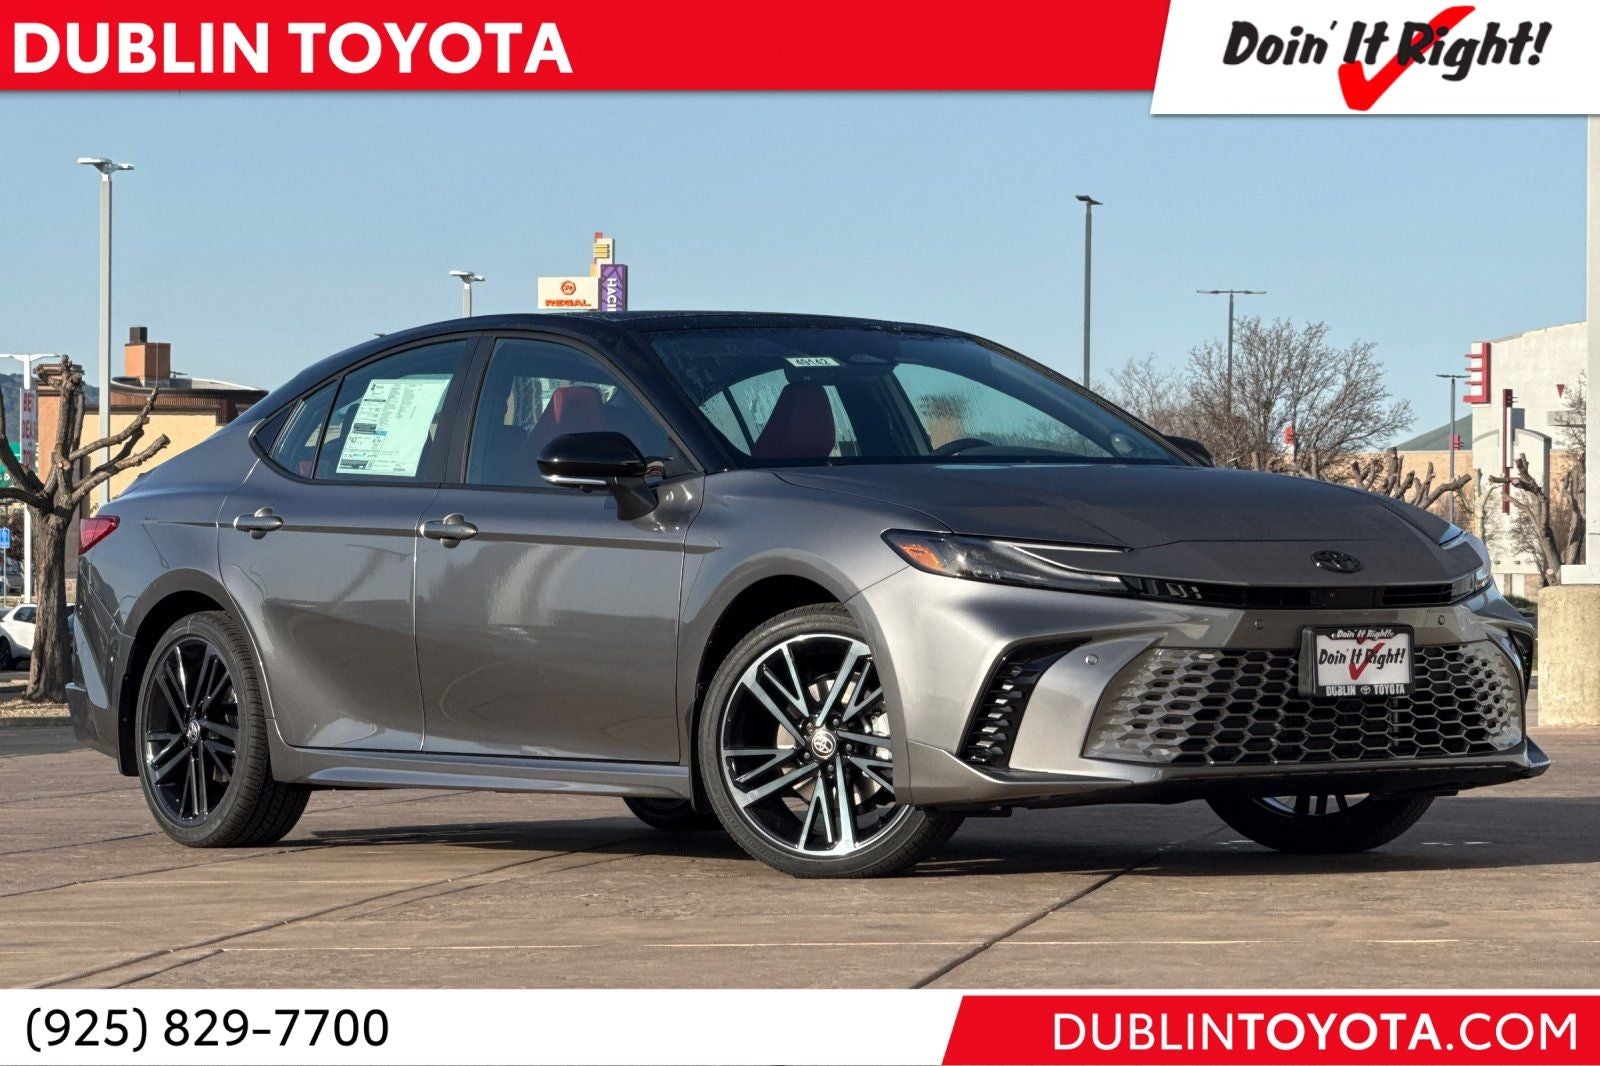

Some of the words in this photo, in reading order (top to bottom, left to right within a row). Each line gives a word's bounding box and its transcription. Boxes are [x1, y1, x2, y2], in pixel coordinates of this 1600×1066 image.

[545, 299, 588, 307] REGAL
[1318, 648, 1349, 665] Doin'
[1350, 648, 1363, 665] It
[1365, 648, 1406, 670] Right!
[1326, 685, 1356, 697] DUBLIN
[1373, 684, 1405, 695] TOYOTA
